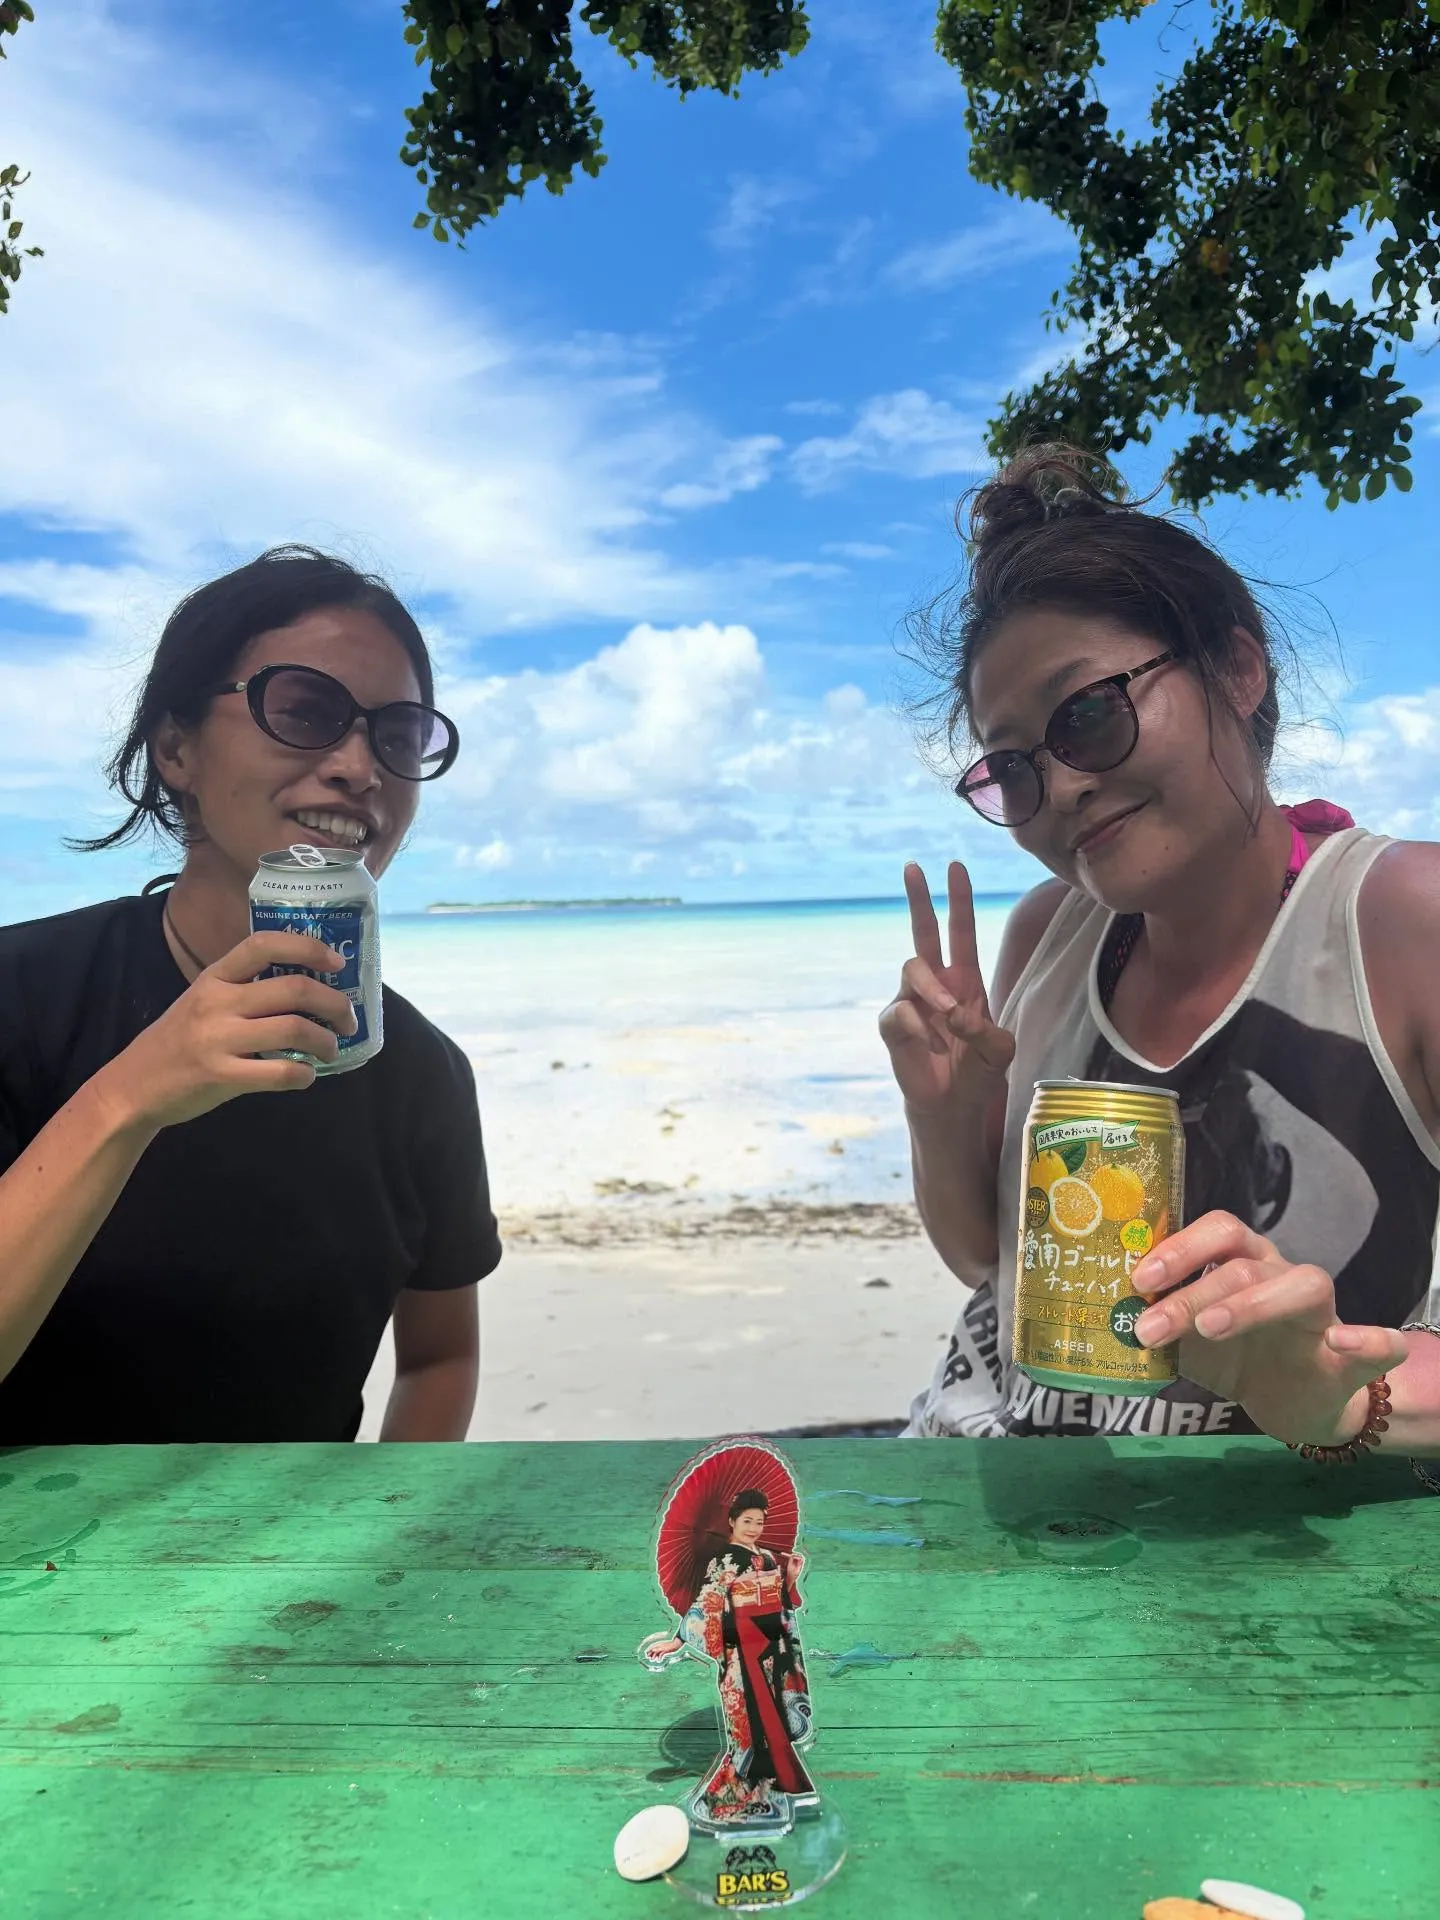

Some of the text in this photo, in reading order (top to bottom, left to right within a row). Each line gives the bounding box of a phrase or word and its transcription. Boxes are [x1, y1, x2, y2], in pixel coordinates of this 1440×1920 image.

[263, 881, 288, 890] CLEAR
[314, 883, 343, 891] TASTY
[255, 911, 291, 920] GENUINE
[293, 912, 327, 920] DRAFT
[1103, 1133, 1129, 1145] 届ける
[1044, 1271, 1121, 1298] チューハイ
[1114, 1311, 1141, 1333] お
[1053, 1339, 1094, 1354] ASEED
[718, 1870, 788, 1897] BAR'S
